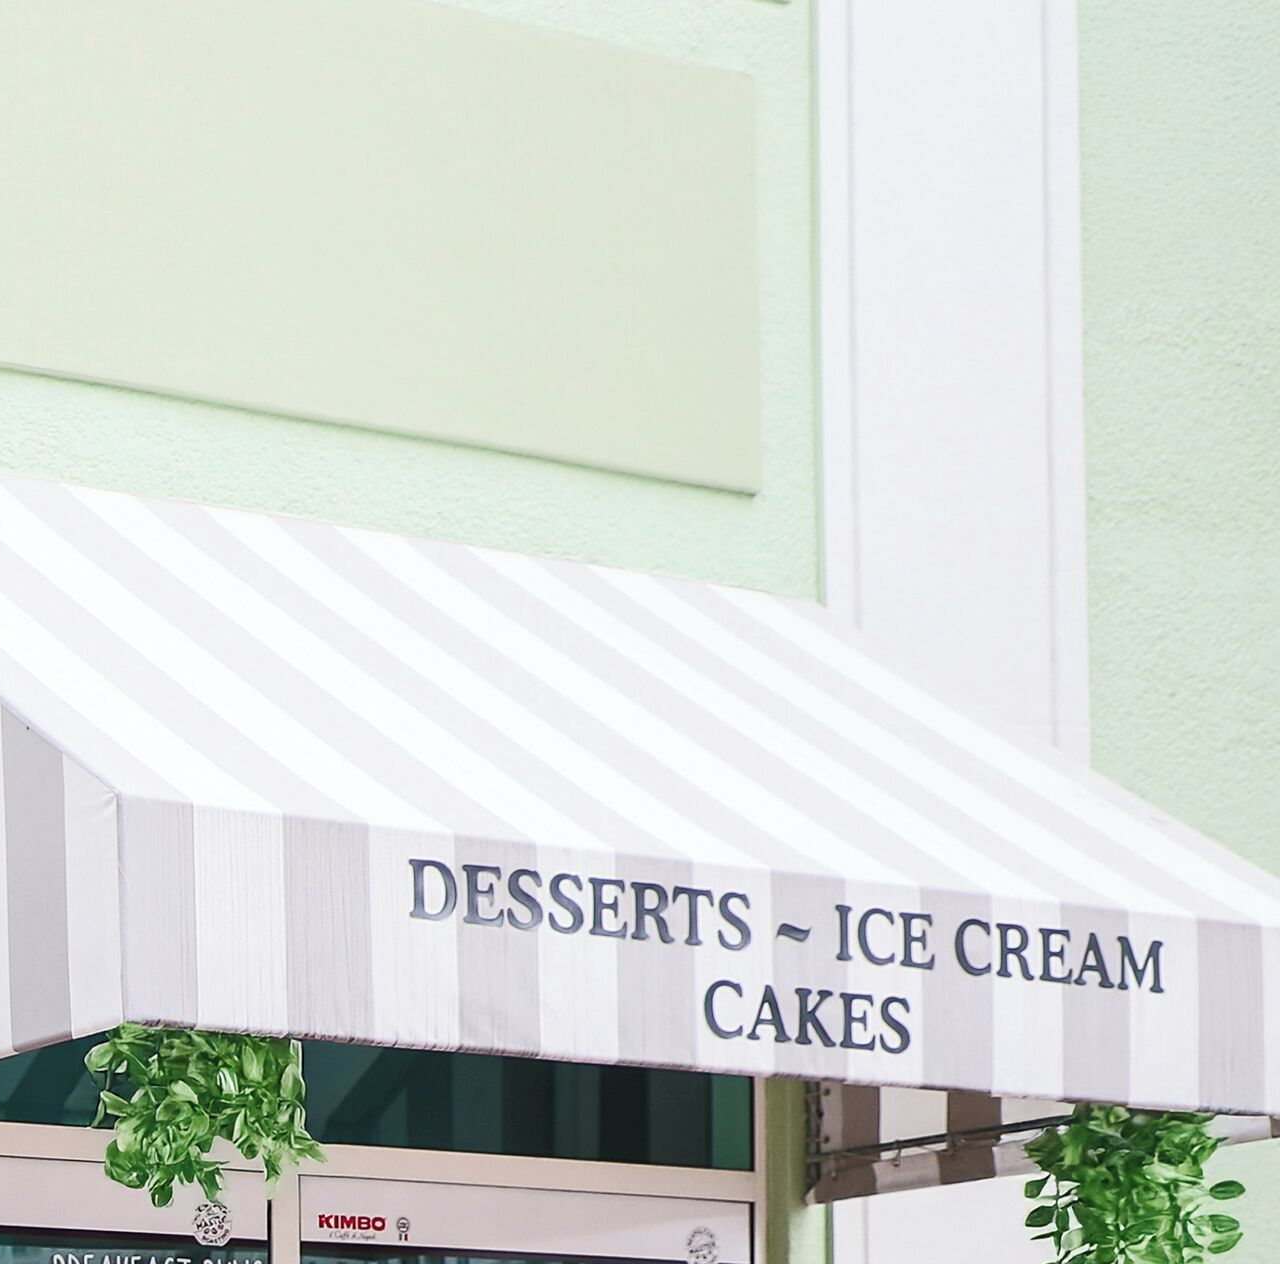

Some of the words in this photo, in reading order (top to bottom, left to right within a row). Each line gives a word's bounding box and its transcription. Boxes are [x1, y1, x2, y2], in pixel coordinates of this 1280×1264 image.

[409, 858, 753, 951] DESSERTS
[835, 904, 936, 971] ICE
[953, 918, 1165, 993] CREAM
[703, 979, 912, 1054] CAKES
[319, 1214, 386, 1231] KIMBO
